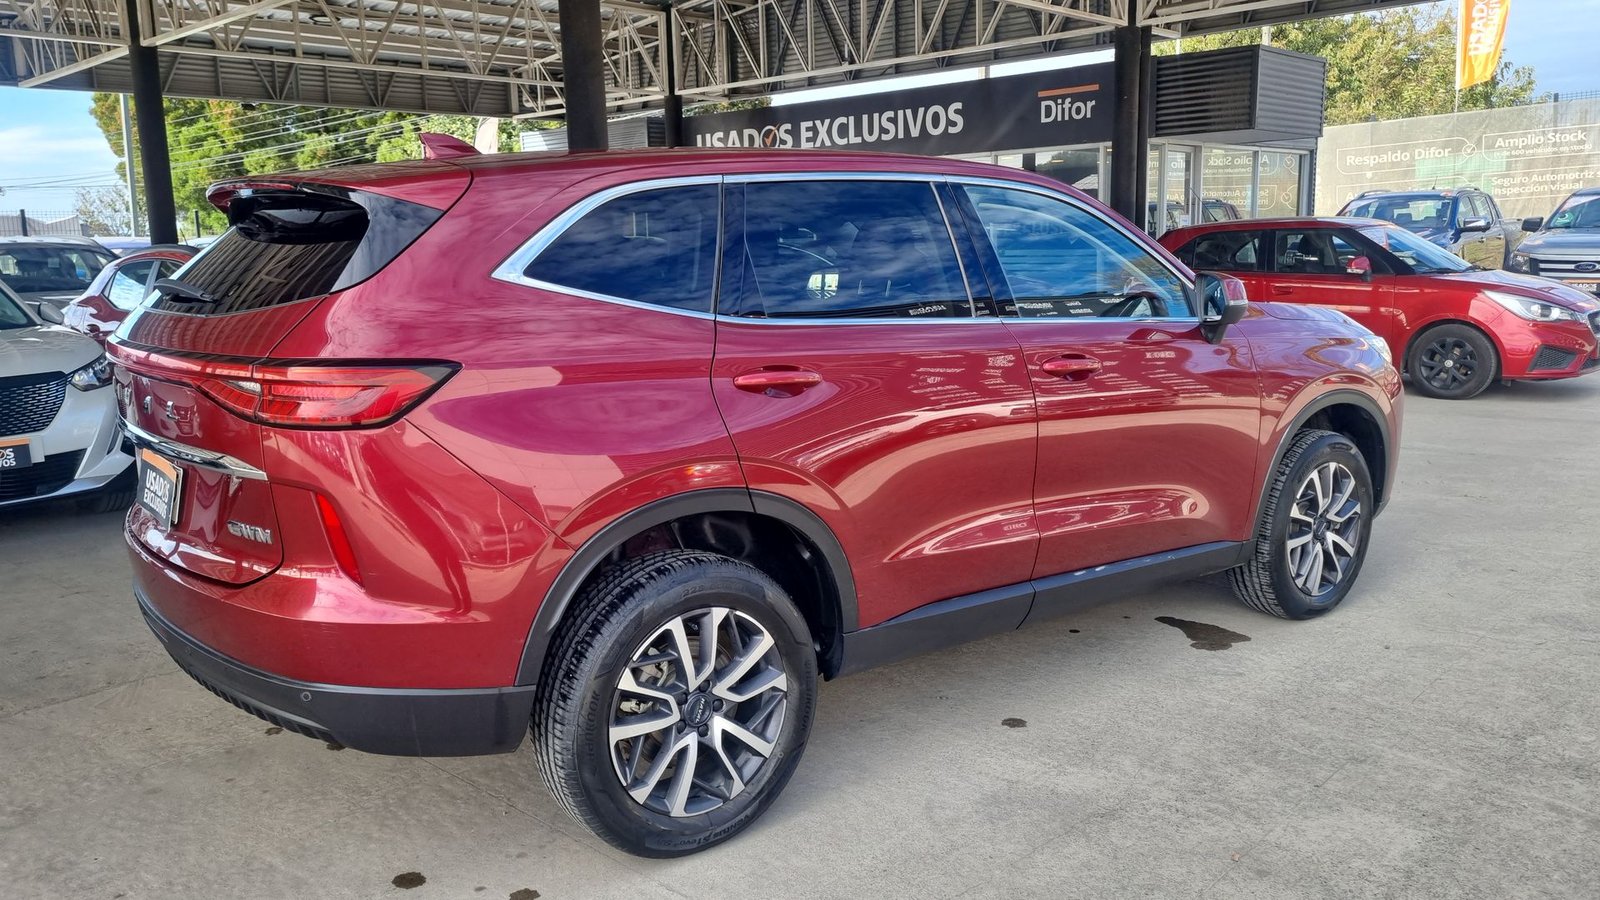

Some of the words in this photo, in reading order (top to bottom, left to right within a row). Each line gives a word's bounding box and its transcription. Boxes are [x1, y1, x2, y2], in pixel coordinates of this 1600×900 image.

[1041, 97, 1096, 123] Difor
[800, 102, 964, 149] EXCLUSIVOS
[1495, 134, 1544, 149] Amplio
[1547, 130, 1588, 143] Stock
[1346, 150, 1410, 167] Respaldo
[1414, 146, 1452, 160] Difor
[1491, 176, 1529, 187] Seguro
[1531, 170, 1594, 183] Automotriz
[1550, 181, 1584, 191] visual
[146, 468, 170, 504] USADOS
[226, 520, 273, 545] GWM
